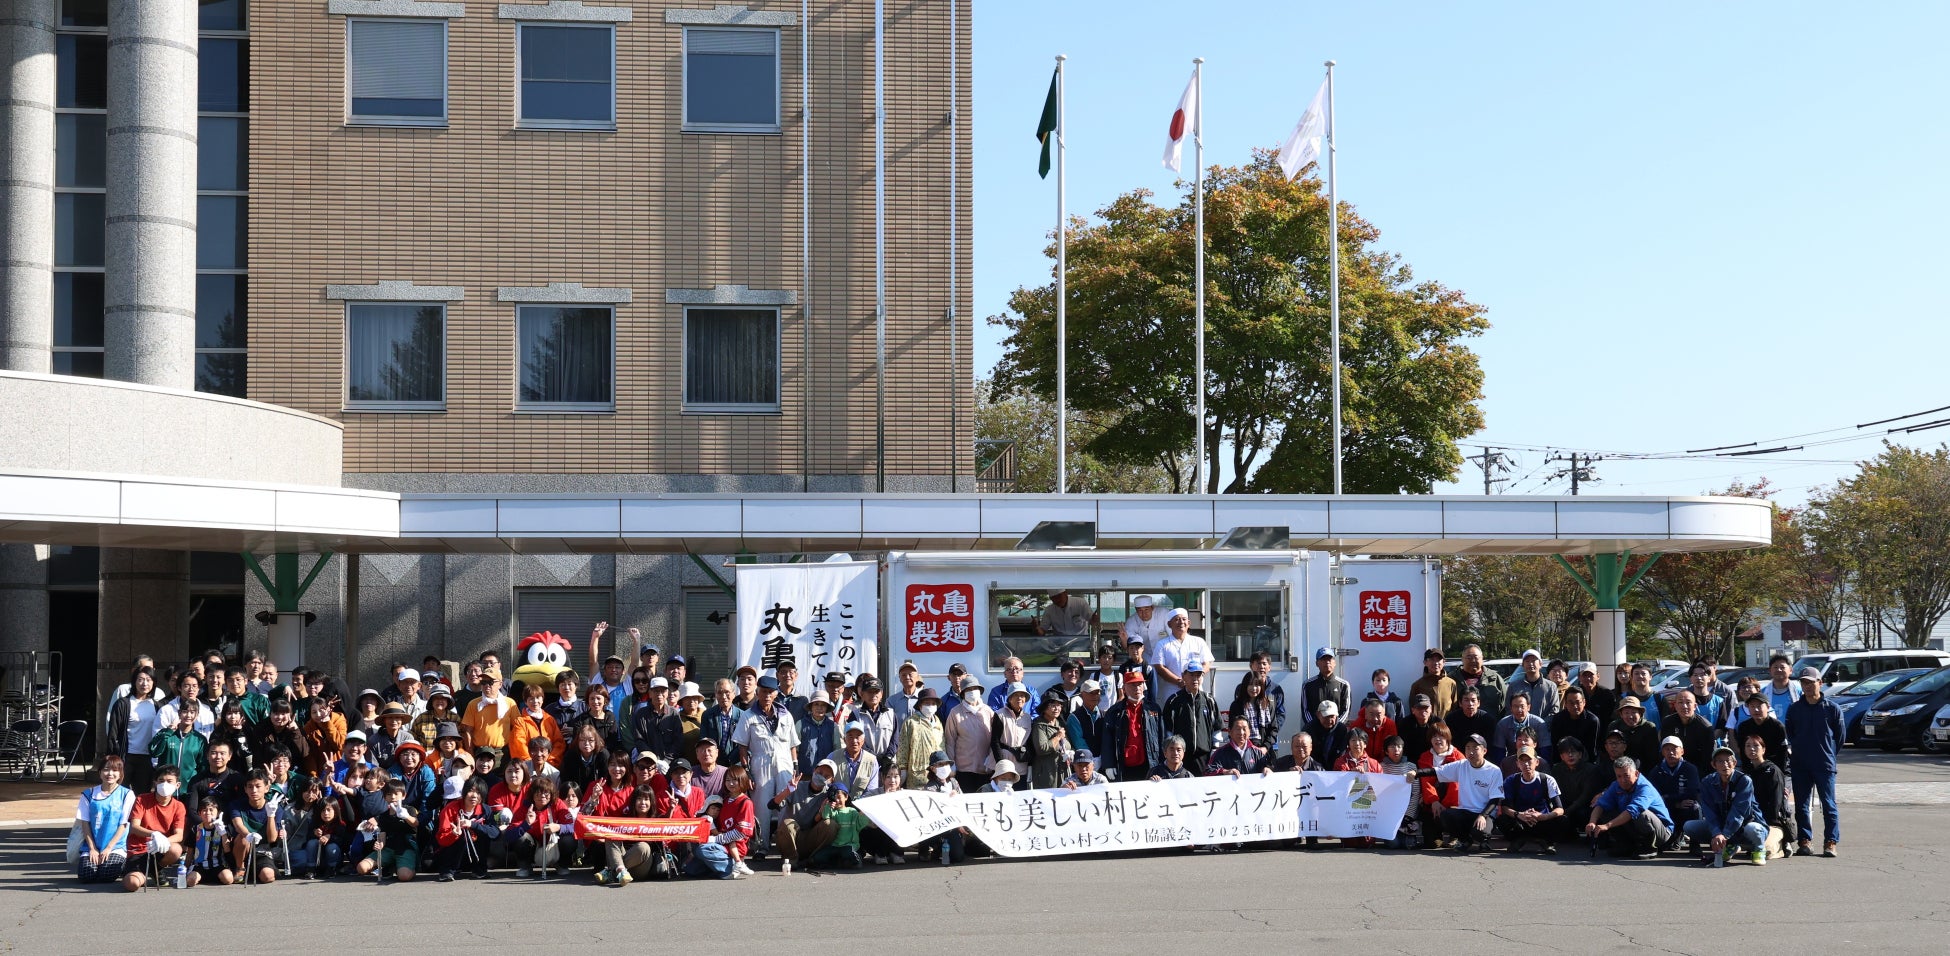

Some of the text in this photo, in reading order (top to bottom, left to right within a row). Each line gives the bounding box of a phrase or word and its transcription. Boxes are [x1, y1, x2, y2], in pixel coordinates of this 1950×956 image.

[909, 589, 970, 617] 丸亀
[1362, 594, 1408, 616] 丸亀
[909, 620, 970, 647] 製麺
[1362, 617, 1408, 638] 製麺
[596, 824, 699, 835] Volunteer Team NISSAY
